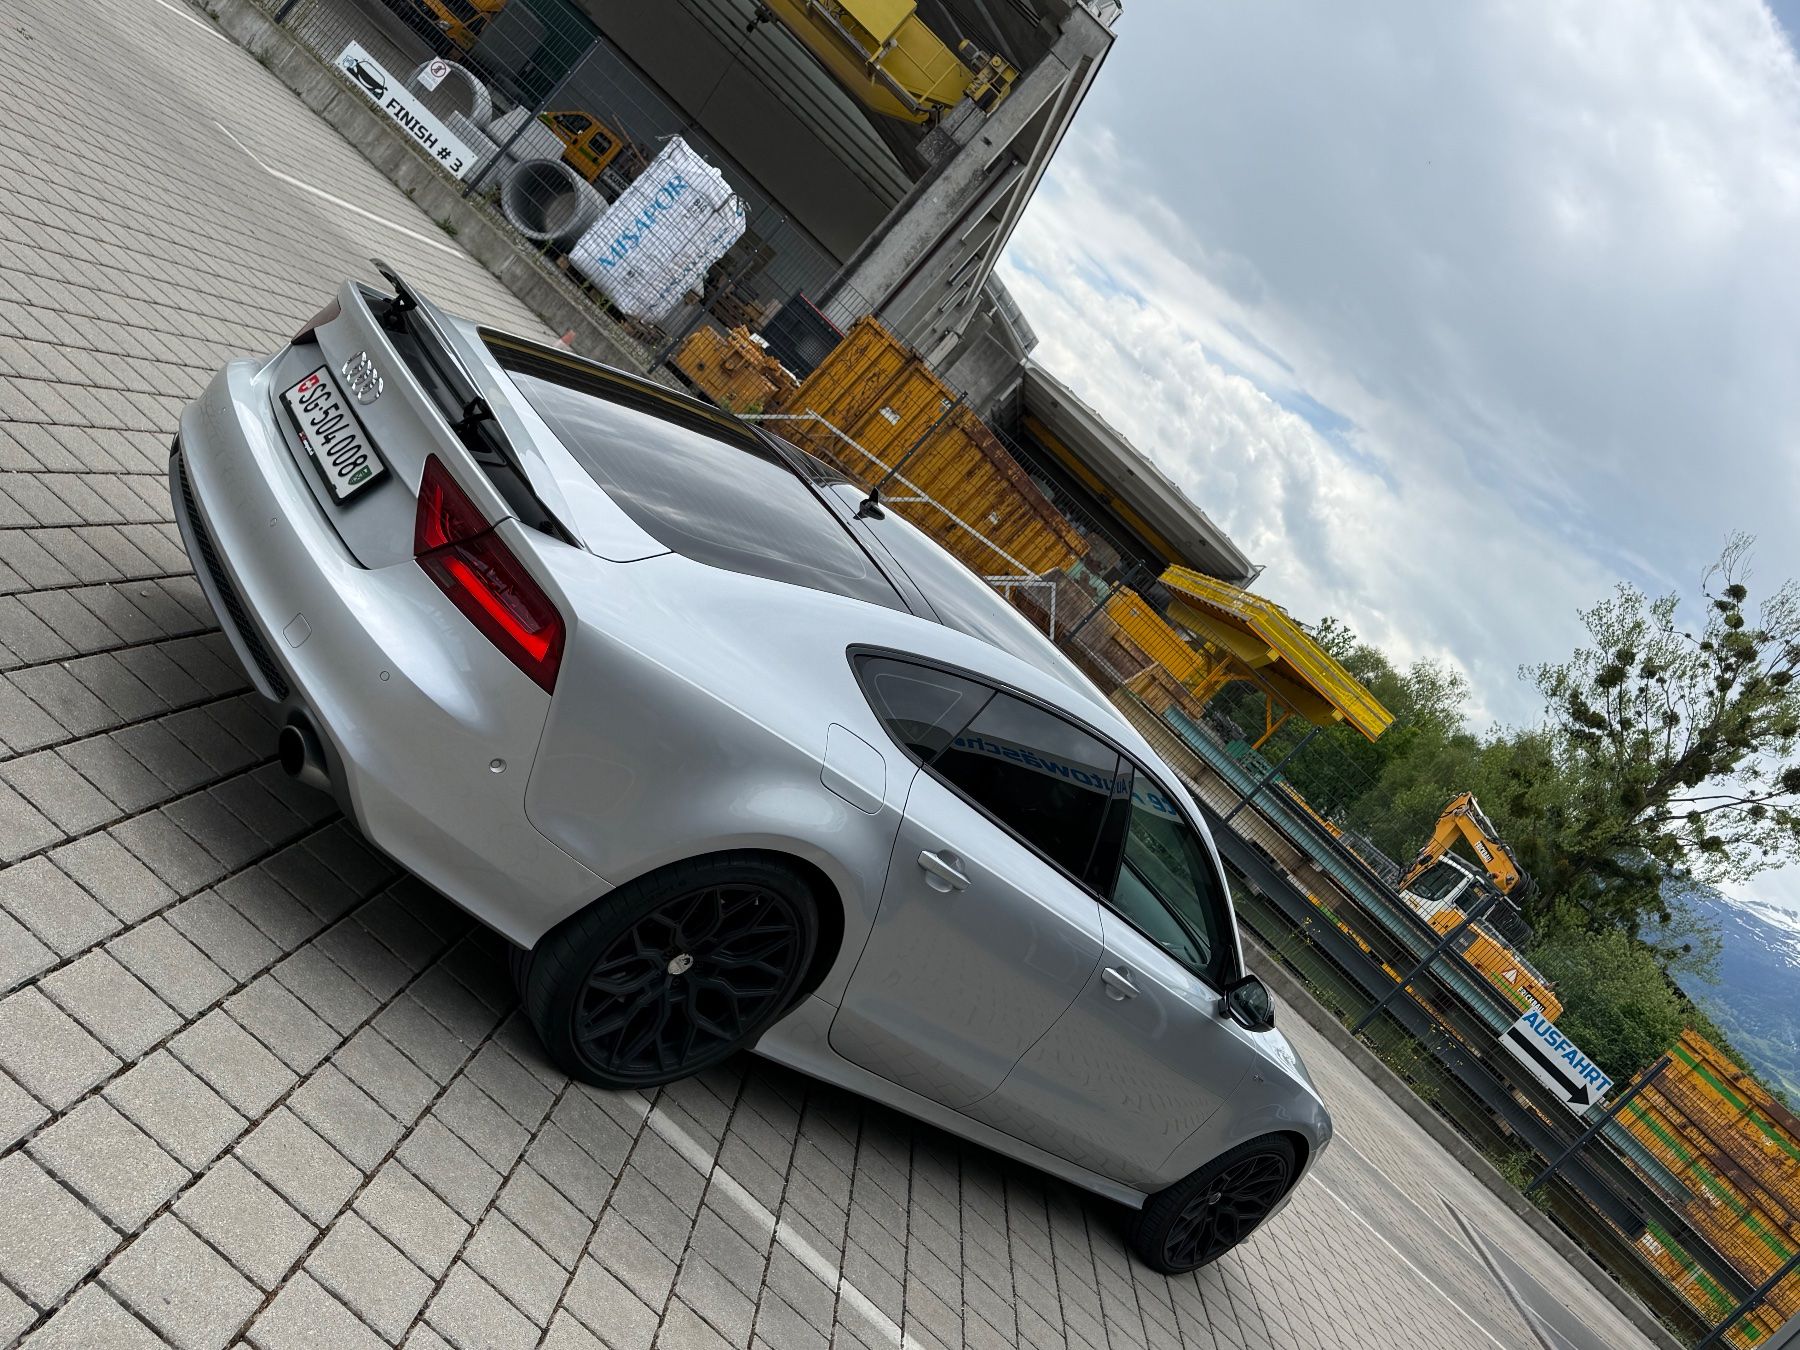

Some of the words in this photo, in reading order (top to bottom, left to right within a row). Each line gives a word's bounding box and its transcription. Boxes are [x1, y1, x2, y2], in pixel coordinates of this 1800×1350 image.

[386, 98, 438, 149] FINISH
[437, 147, 452, 160] #
[449, 158, 463, 173] 3
[598, 175, 689, 268] MISAPOR
[1522, 1011, 1611, 1092] AUSFAHRT
